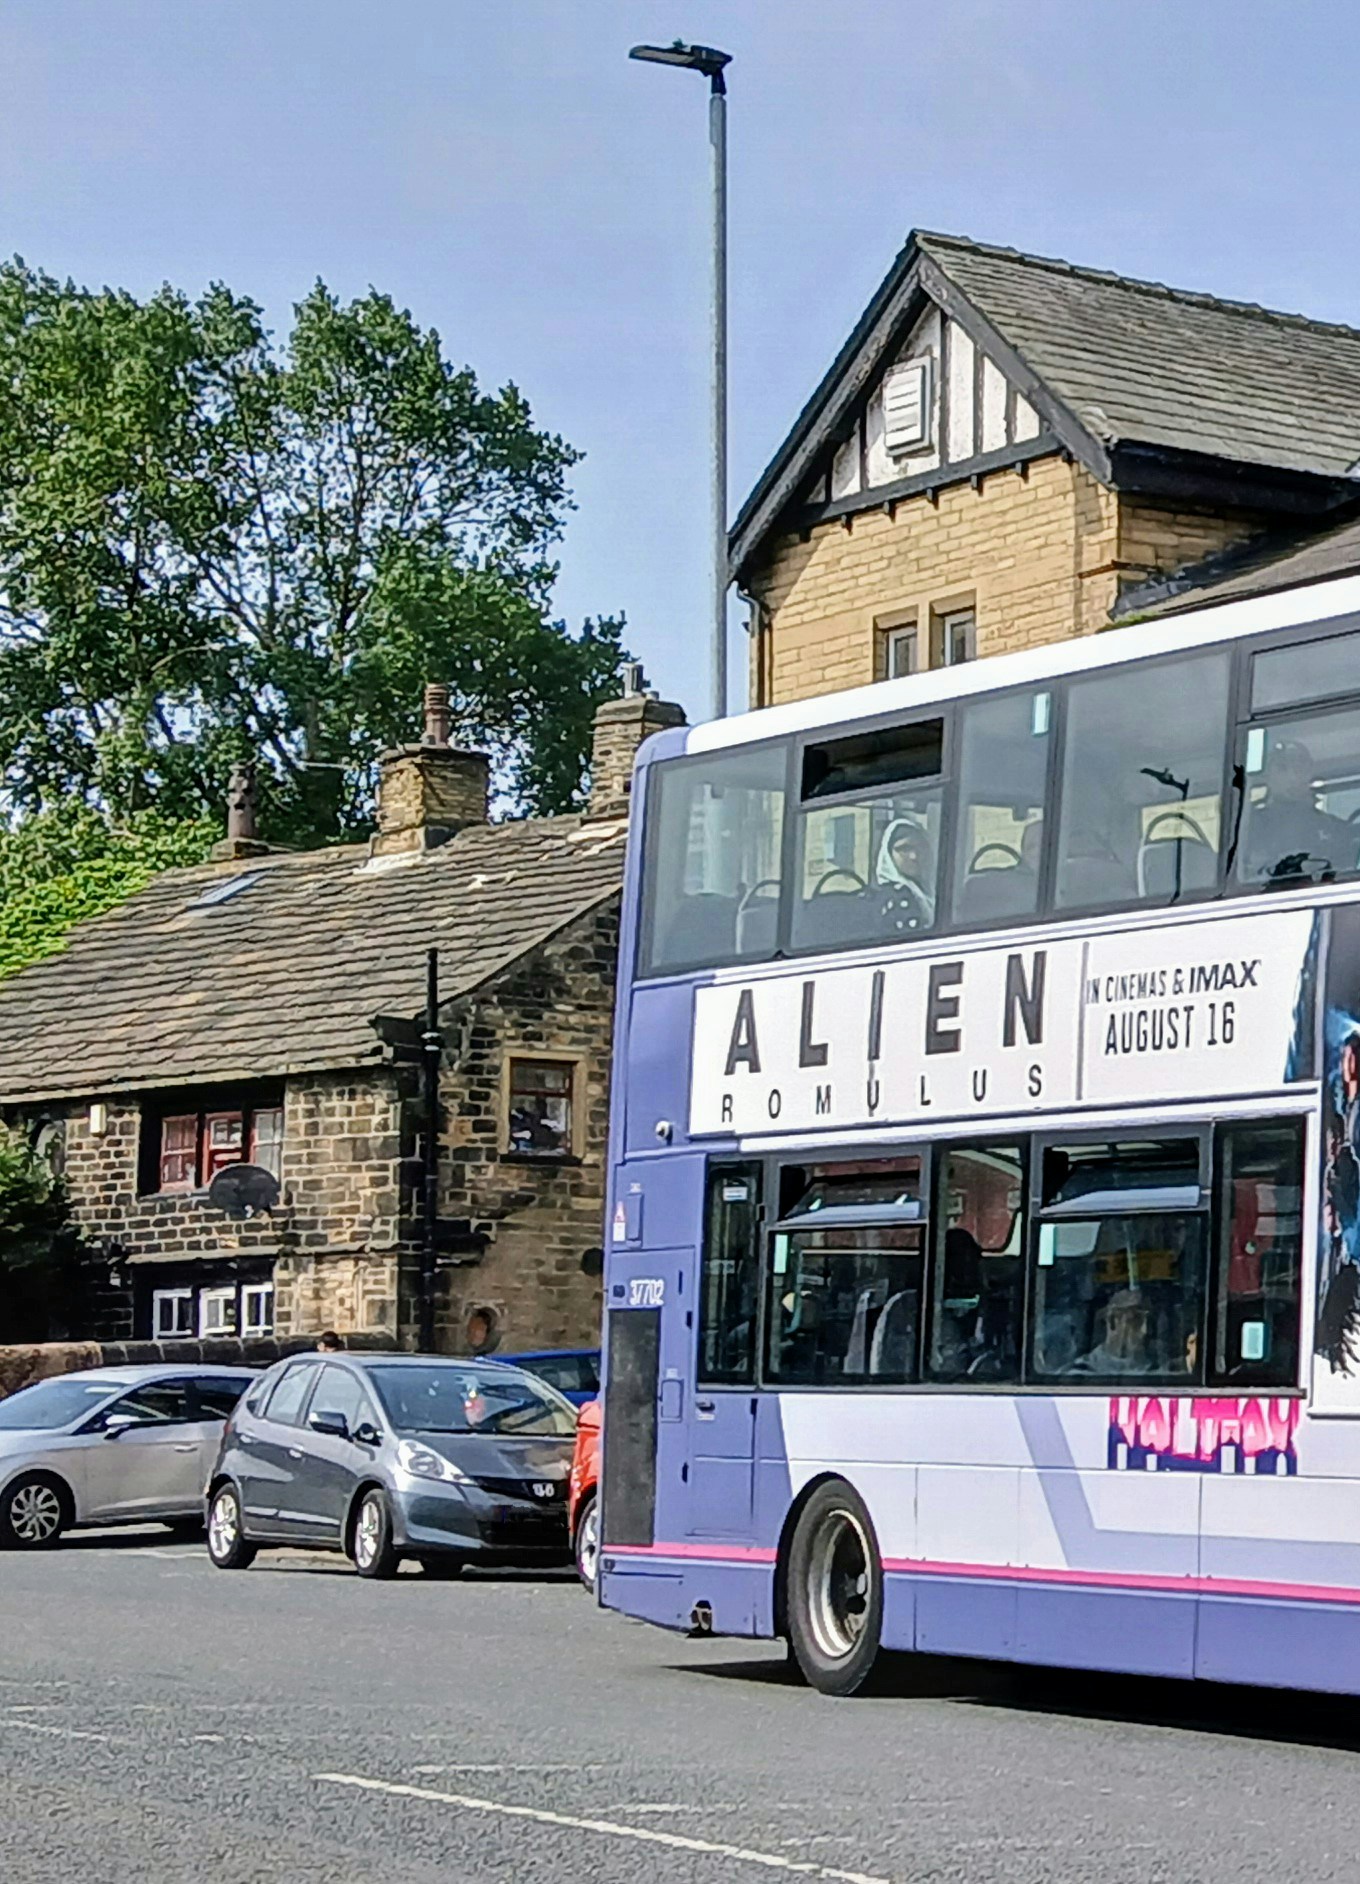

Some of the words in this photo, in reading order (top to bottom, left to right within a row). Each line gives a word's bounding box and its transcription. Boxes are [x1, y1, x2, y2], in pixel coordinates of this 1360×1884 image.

[1086, 979, 1101, 1004] IN
[1106, 970, 1167, 1003] CINEMAS
[1172, 968, 1185, 995] &
[1188, 960, 1258, 993] IMAX
[724, 950, 1048, 1076] ALIEN
[1105, 1005, 1195, 1056] AUGUST
[1207, 1001, 1236, 1046] 16
[721, 1063, 1043, 1123] ROMULUS
